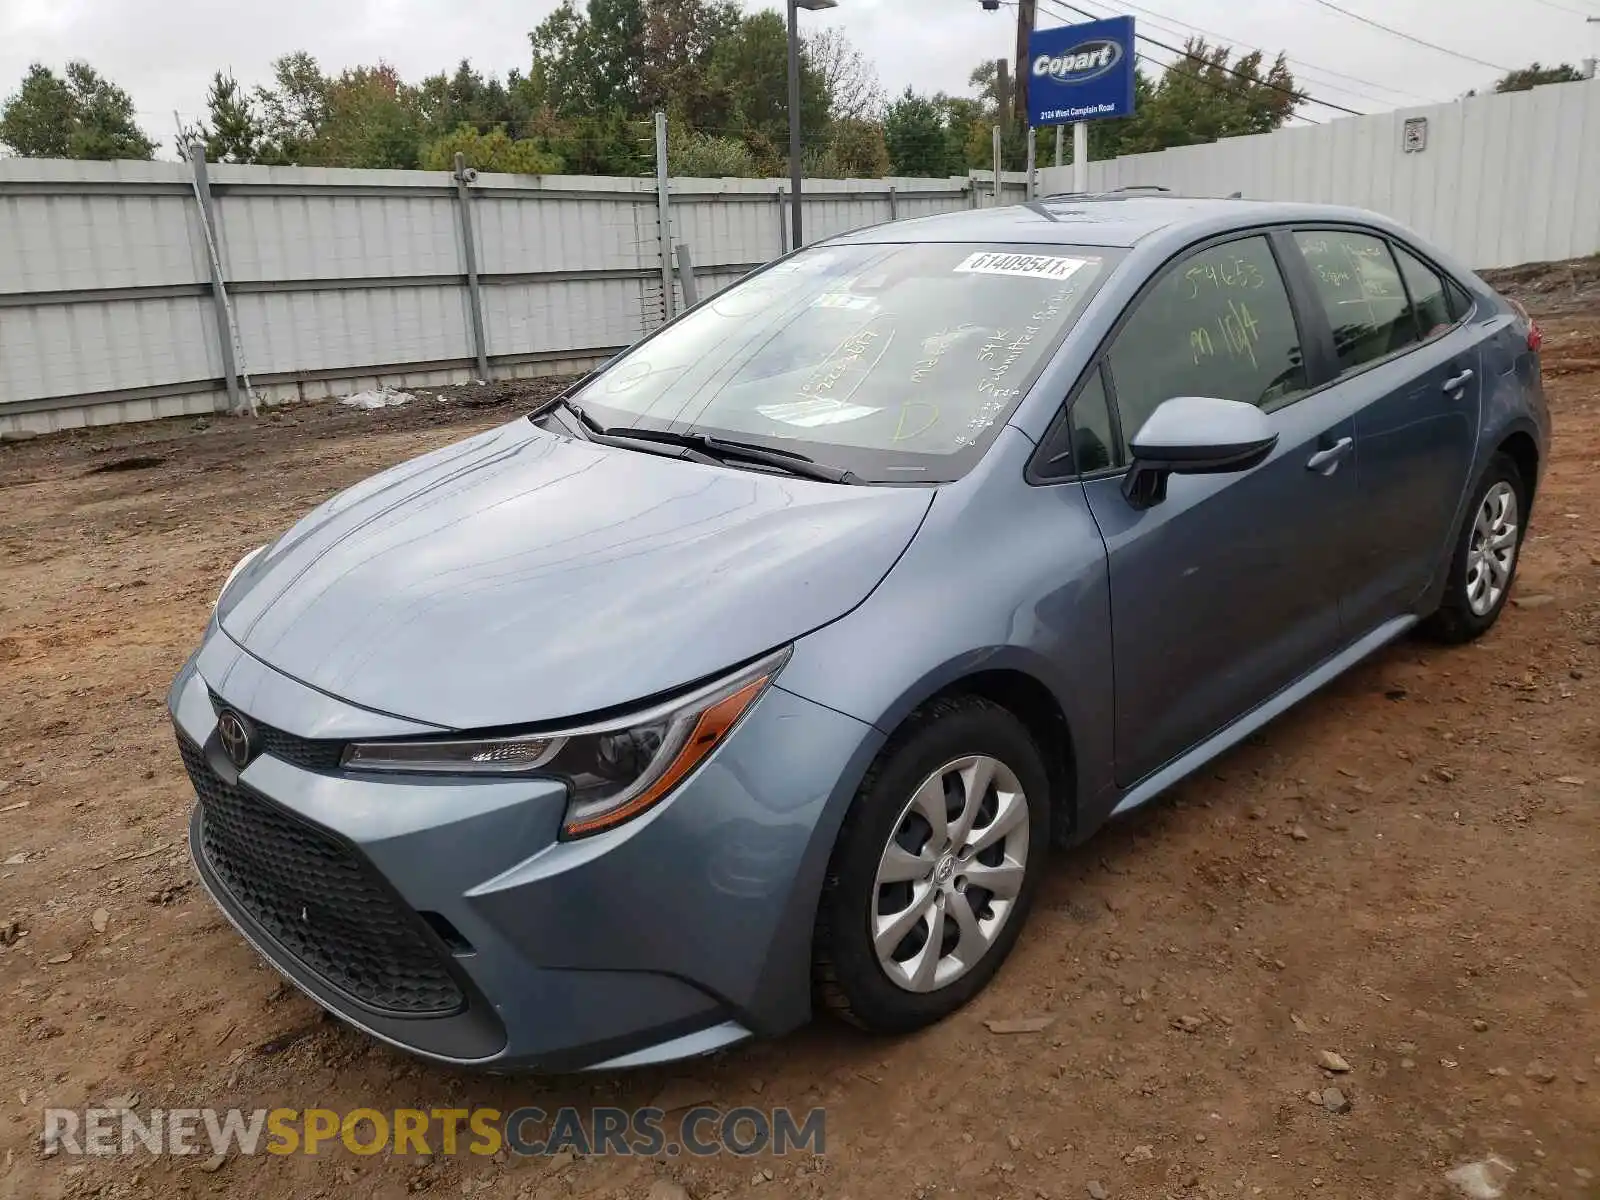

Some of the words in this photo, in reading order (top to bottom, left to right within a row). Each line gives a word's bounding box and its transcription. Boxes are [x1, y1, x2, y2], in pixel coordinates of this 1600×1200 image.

[1032, 44, 1111, 77] Copart
[1040, 111, 1054, 120] 2124
[1055, 109, 1070, 118] West
[1070, 104, 1098, 116] Camplain
[1099, 102, 1115, 112] Road
